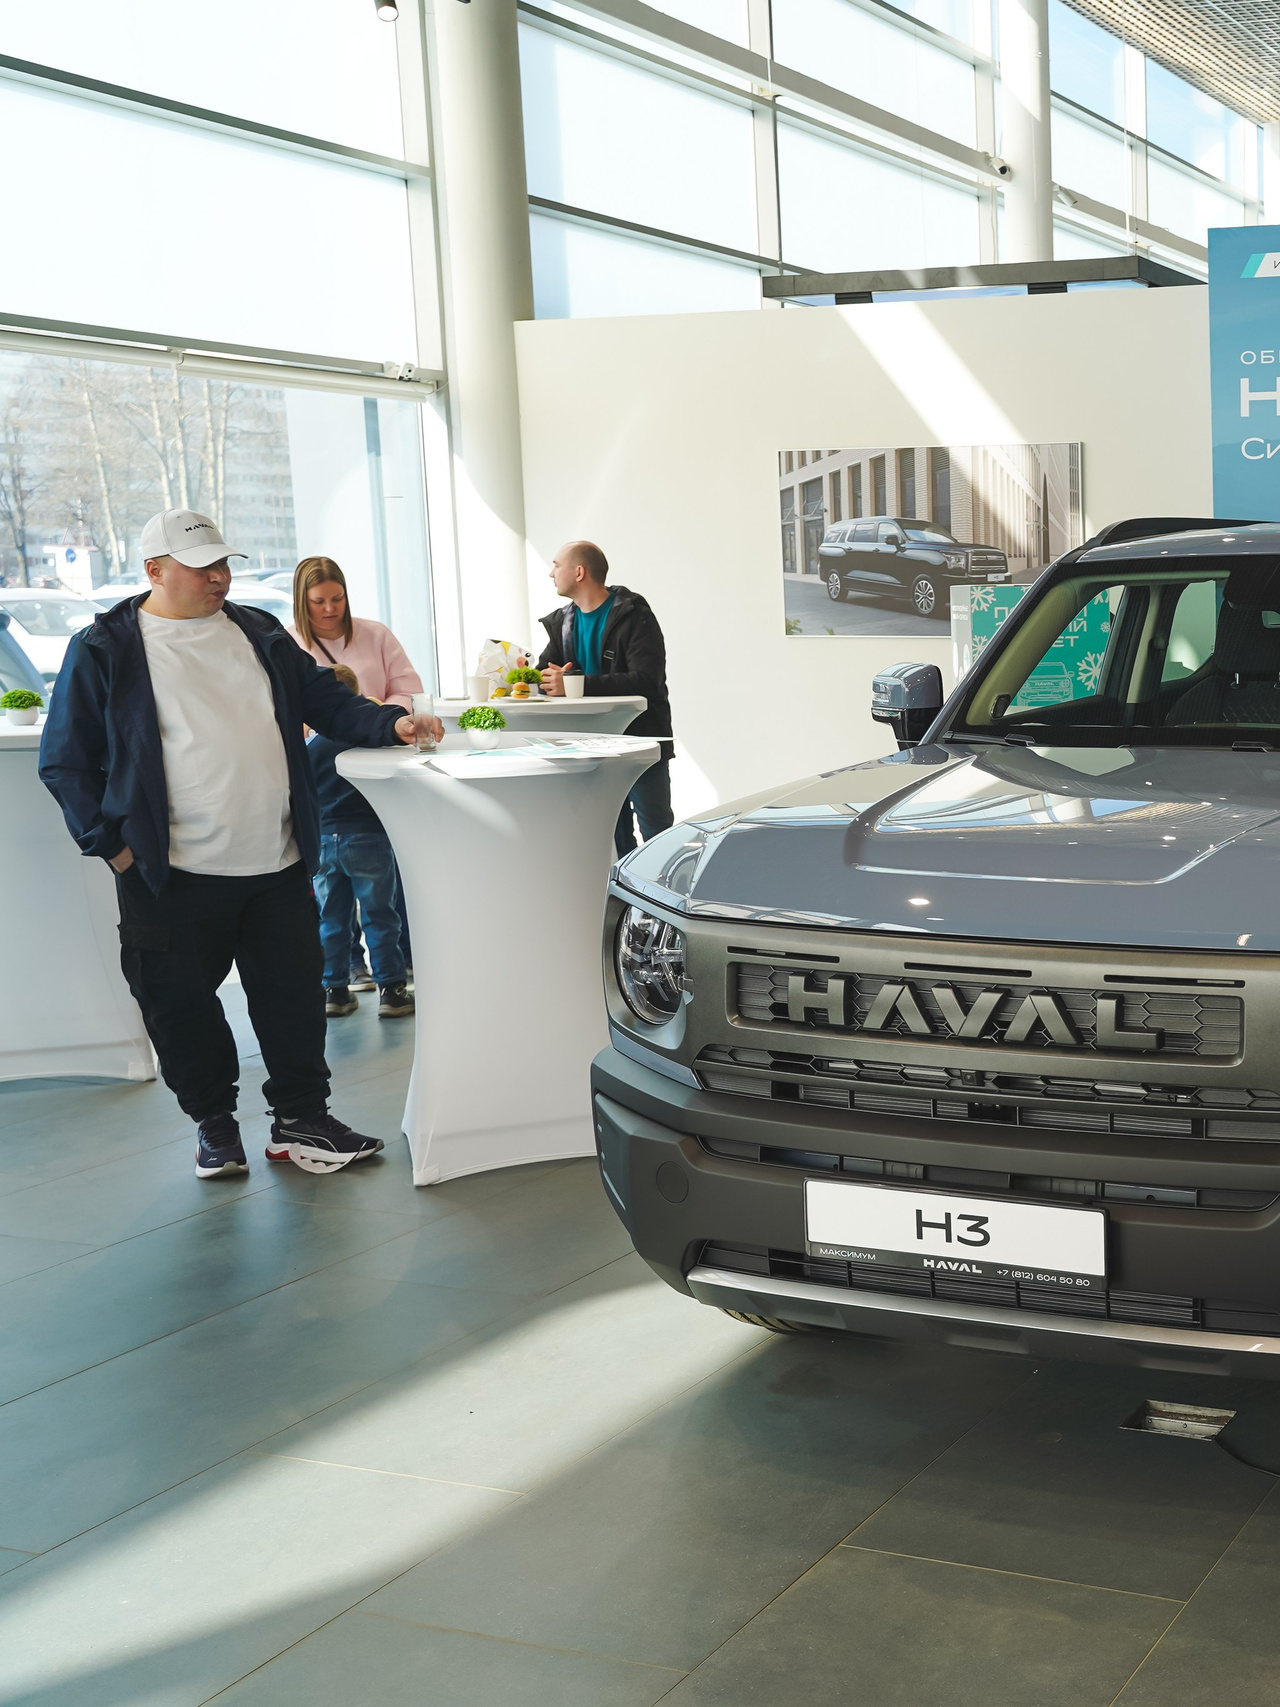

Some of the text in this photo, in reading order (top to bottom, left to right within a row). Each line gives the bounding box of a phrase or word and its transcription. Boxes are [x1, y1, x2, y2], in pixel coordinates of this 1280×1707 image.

[787, 971, 1165, 1051] HAVAL
[915, 1208, 991, 1247] H3
[820, 1247, 876, 1261] МАКСИМУМ
[923, 1258, 982, 1274] HAVAL
[996, 1269, 1090, 1287] +7 (812) 604 50 80
